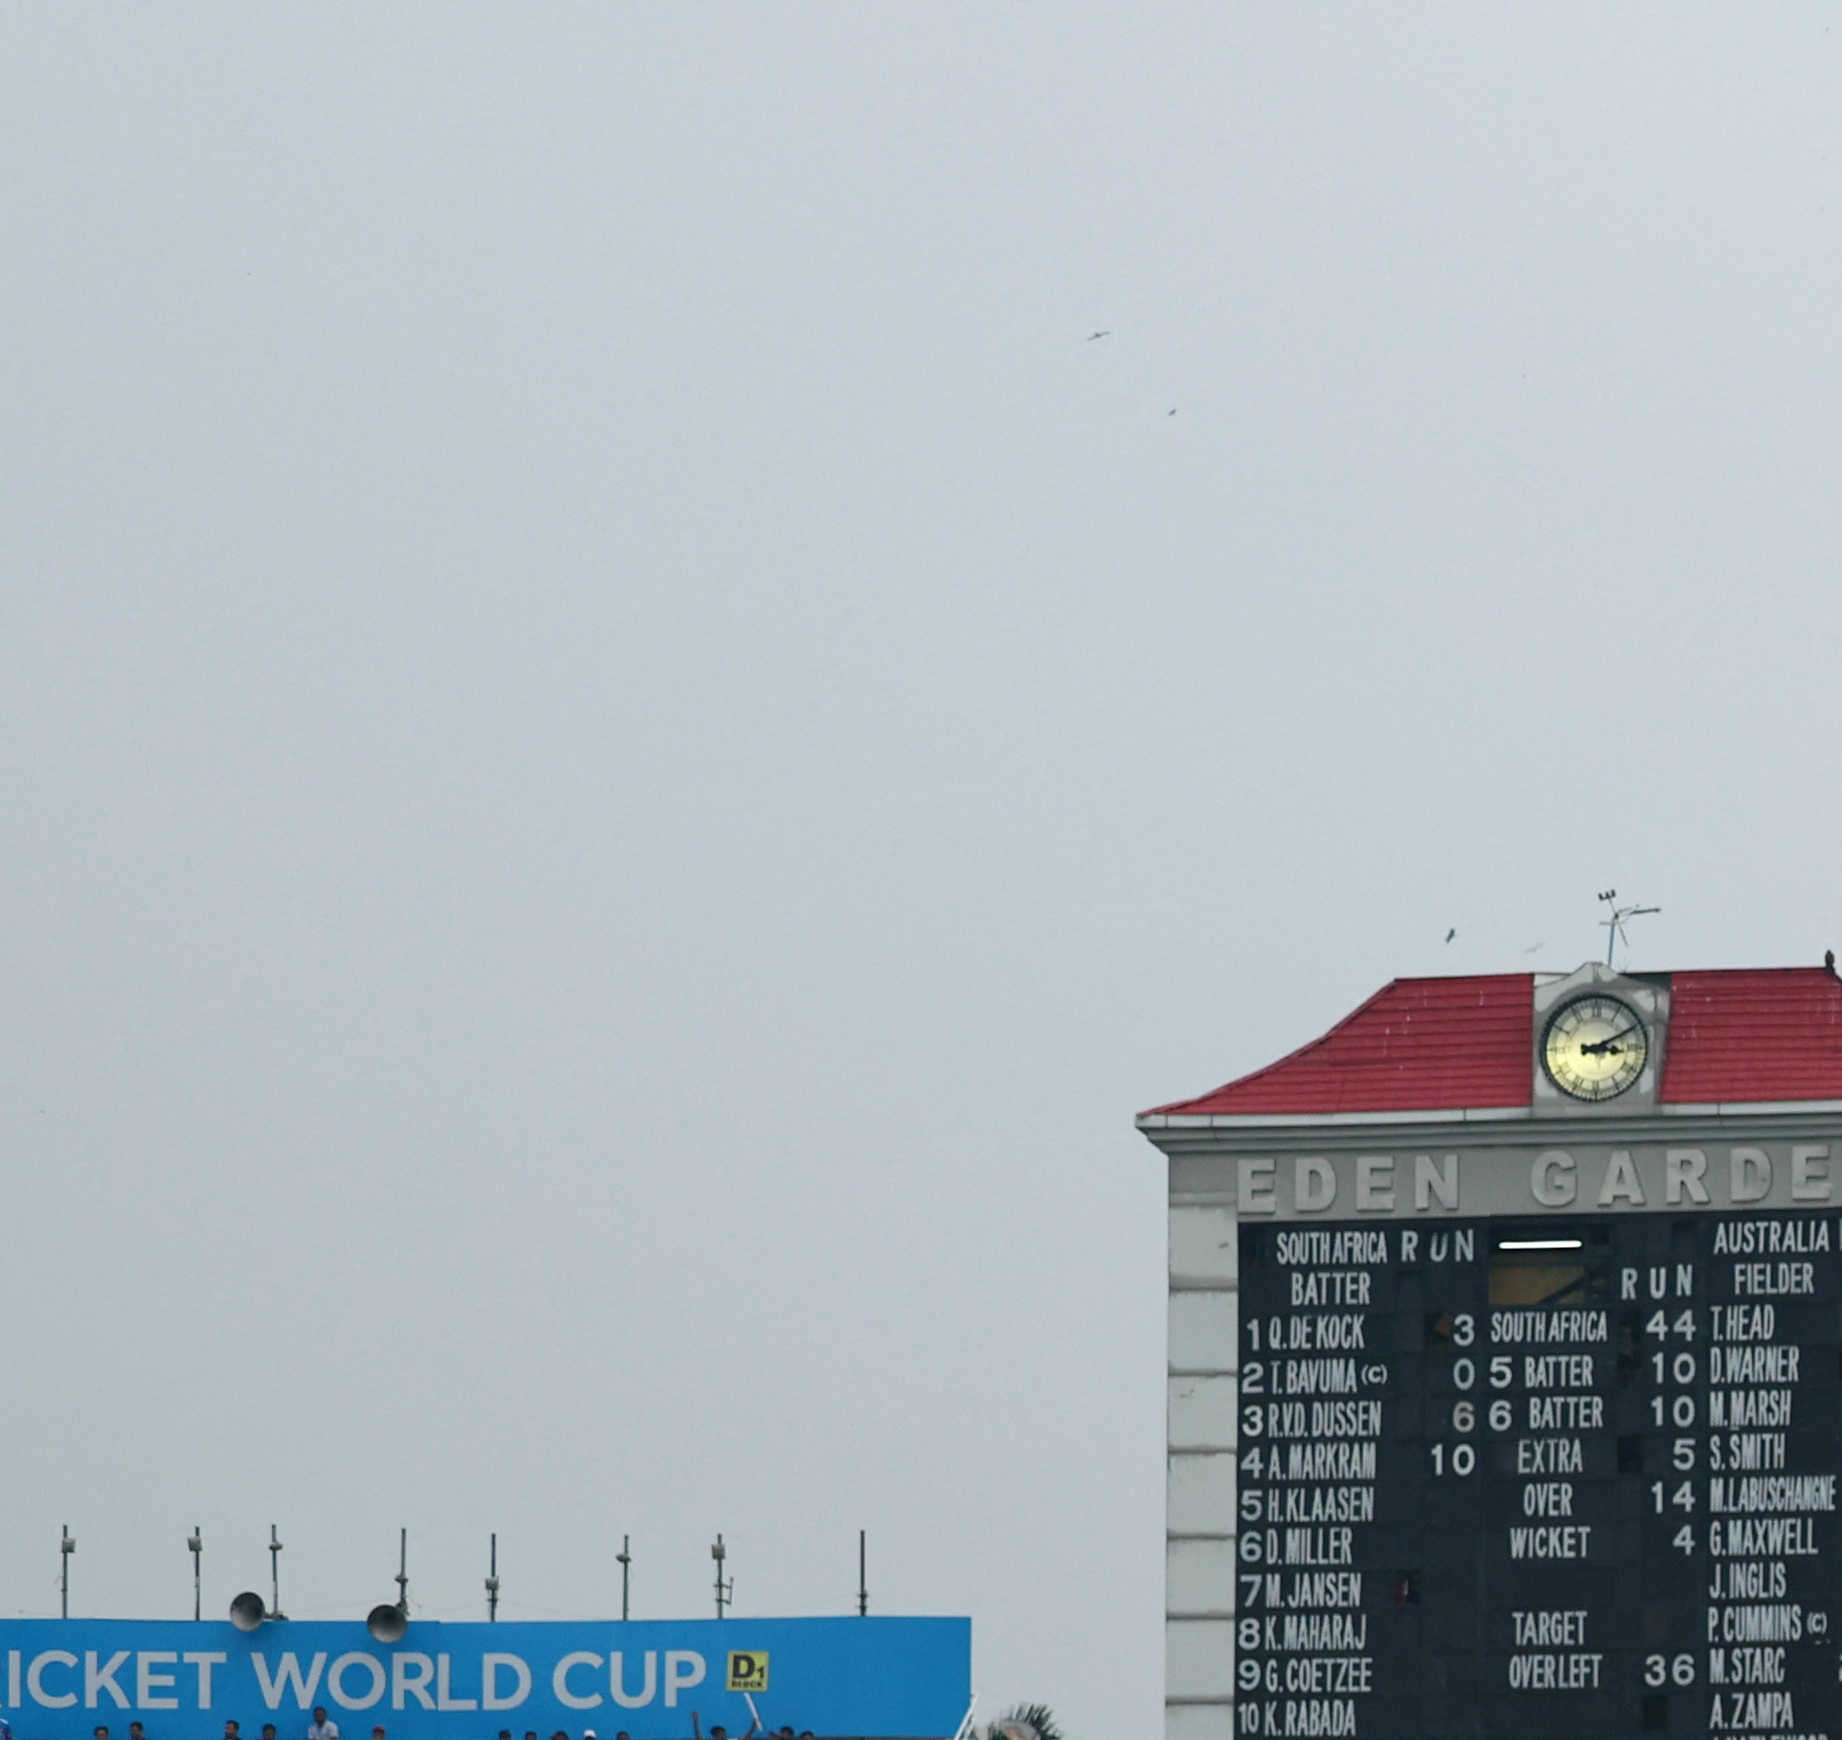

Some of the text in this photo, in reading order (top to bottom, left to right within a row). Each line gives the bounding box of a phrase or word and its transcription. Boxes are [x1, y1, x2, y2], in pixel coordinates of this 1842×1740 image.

[1237, 1154, 1460, 1215] EDEN
[1276, 1229, 1475, 1265] SOUTH AFRICA RUN
[1713, 1219, 1829, 1254] AUSTRALIA
[1291, 1272, 1372, 1306] BATTER
[1621, 1264, 1693, 1300] RUN
[1734, 1262, 1815, 1295] FIELDER
[1246, 1318, 1260, 1350] 1
[1316, 1314, 1366, 1349] KOCK
[1453, 1313, 1475, 1346] 3
[1489, 1309, 1697, 1343] SOUTH AFRICA 44
[1241, 1362, 1264, 1393] 2
[1360, 1364, 1388, 1386] (C)
[1453, 1358, 1475, 1390] 0
[1489, 1352, 1696, 1389] 5 BATTER 10
[1242, 1405, 1264, 1436] 3
[1311, 1401, 1382, 1437] DUSSEN
[1453, 1401, 1475, 1434] 6
[1488, 1395, 1696, 1431] 6 BATTER 10
[1240, 1446, 1264, 1479] 4
[1430, 1443, 1476, 1476] 10
[1517, 1437, 1696, 1474] EXTRA 5
[1240, 1490, 1263, 1521] 5
[1523, 1480, 1696, 1516] OVER 14
[1239, 1531, 1262, 1563] 6
[1509, 1523, 1695, 1559] WICKET 4
[1239, 1574, 1262, 1607] 7
[1238, 1617, 1261, 1650] 8
[1511, 1610, 1588, 1646] TARGET
[8, 1649, 707, 1711] ICKET WORLD CUP
[1238, 1659, 1261, 1691] 9
[1509, 1653, 1695, 1689] OVER LEFT 36
[1238, 1702, 1259, 1734] 10
